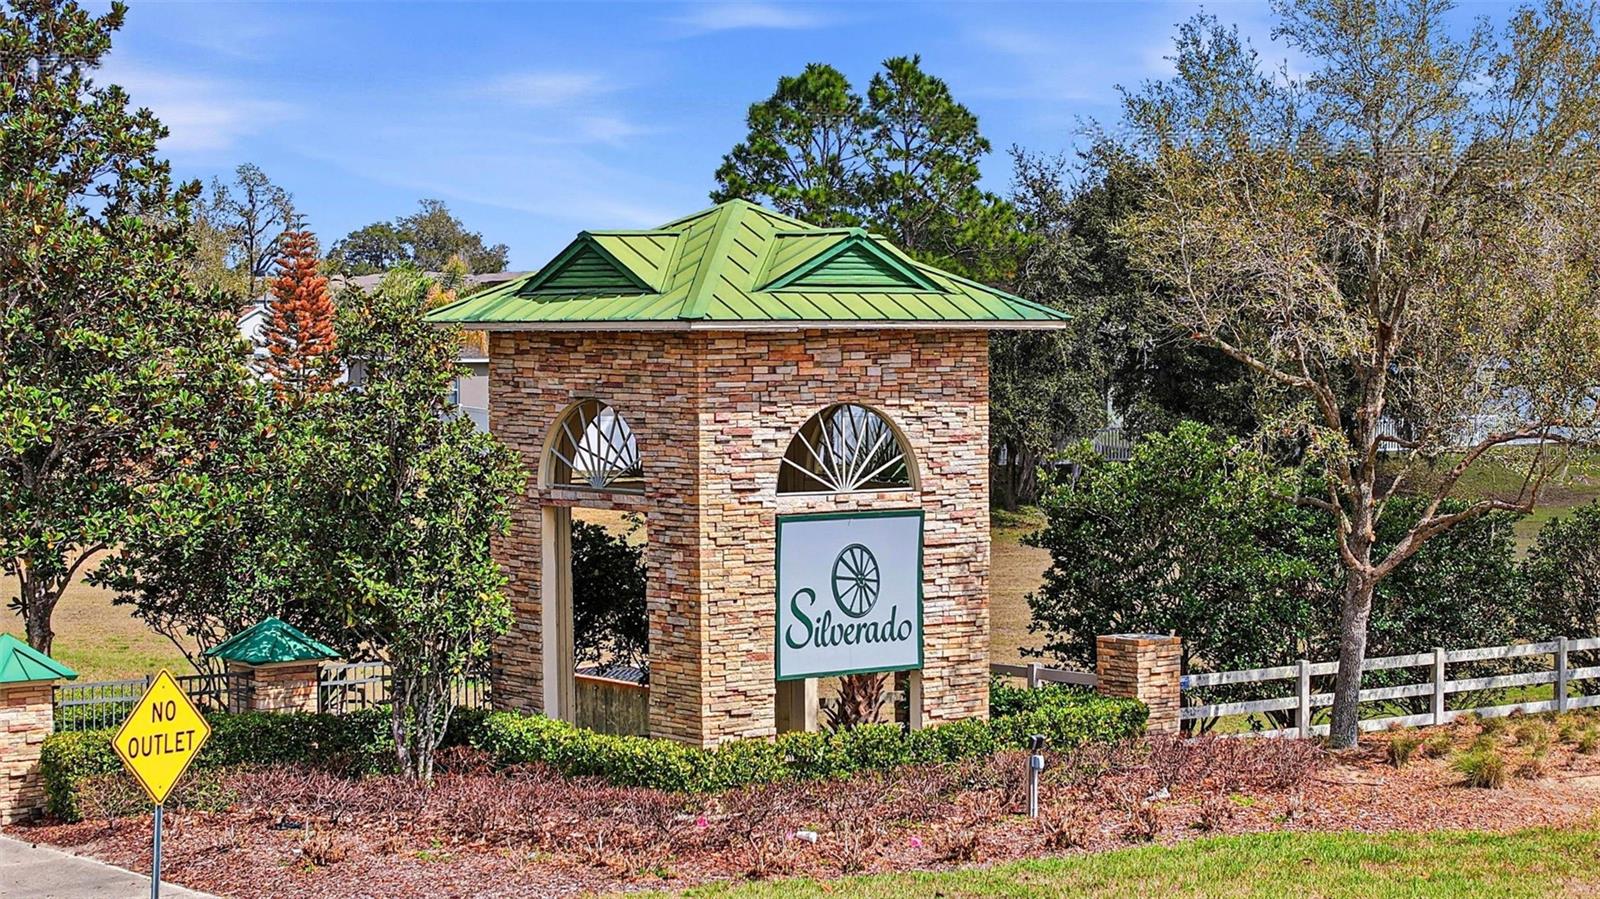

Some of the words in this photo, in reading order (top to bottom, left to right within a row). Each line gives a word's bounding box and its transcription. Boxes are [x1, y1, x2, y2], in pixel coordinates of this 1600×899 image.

[785, 587, 912, 649] Silverado
[152, 700, 176, 723] NO
[128, 730, 195, 759] OUTLET
